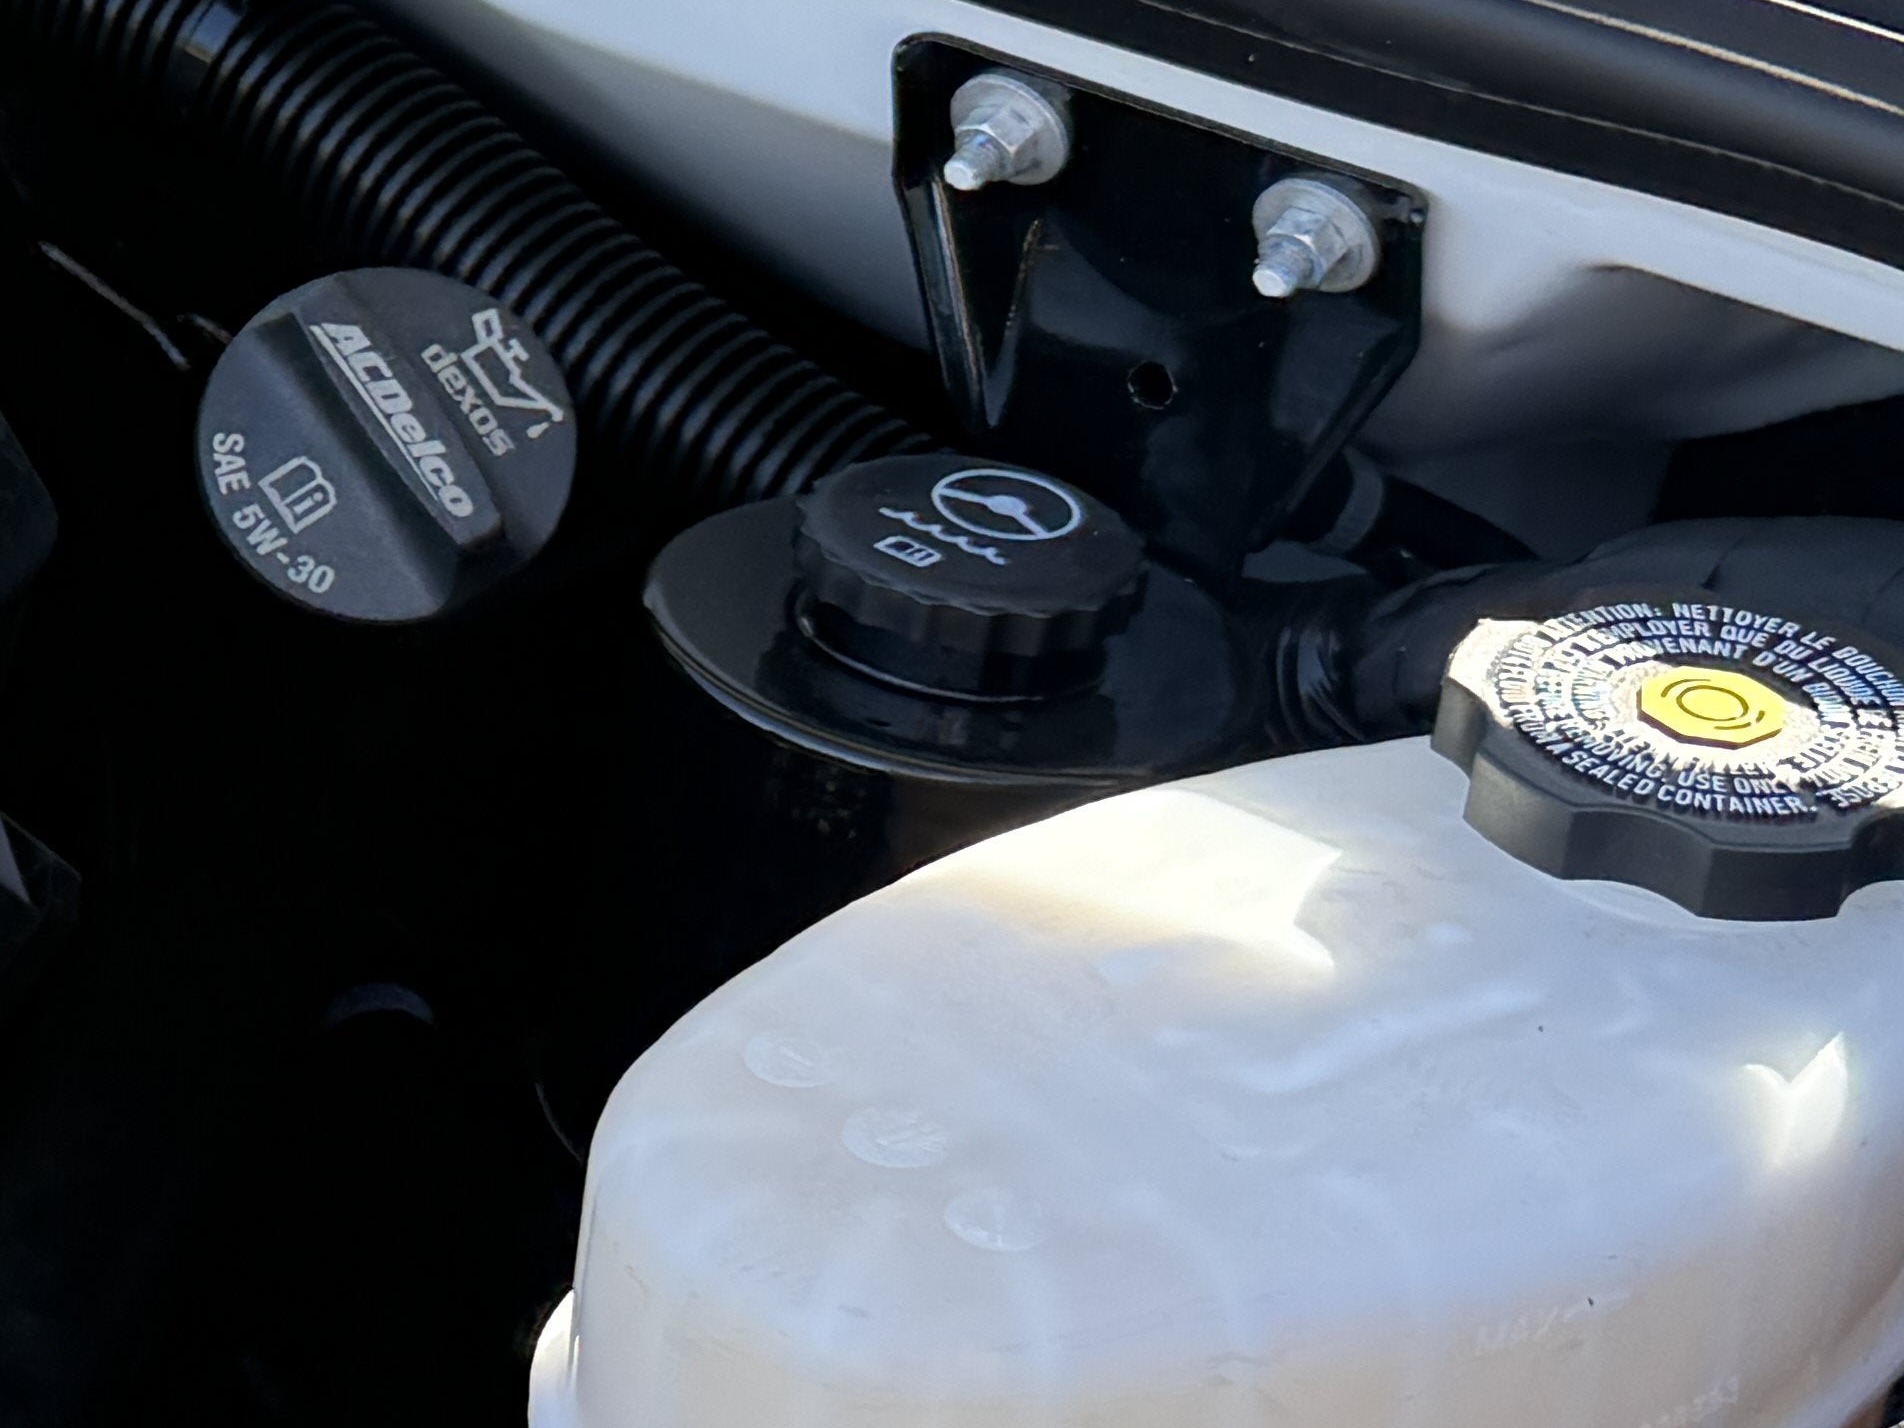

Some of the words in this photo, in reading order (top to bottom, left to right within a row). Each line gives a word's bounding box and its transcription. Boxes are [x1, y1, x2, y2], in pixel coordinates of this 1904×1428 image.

[319, 322, 474, 518] ACDelco
[421, 343, 516, 457] dexos
[212, 432, 250, 495] SAE
[232, 503, 336, 594] 5W-30
[1670, 603, 1801, 635] NETTOYER
[1799, 630, 1837, 649] LE
[1720, 624, 1771, 646] QUE
[1771, 638, 1814, 659] DU
[1750, 650, 1816, 681] D'UN
[1543, 741, 1576, 754] A
[1560, 751, 1655, 795] SEALED
[1649, 783, 1818, 815] CONTAINER.
[1674, 771, 1727, 791] USE
